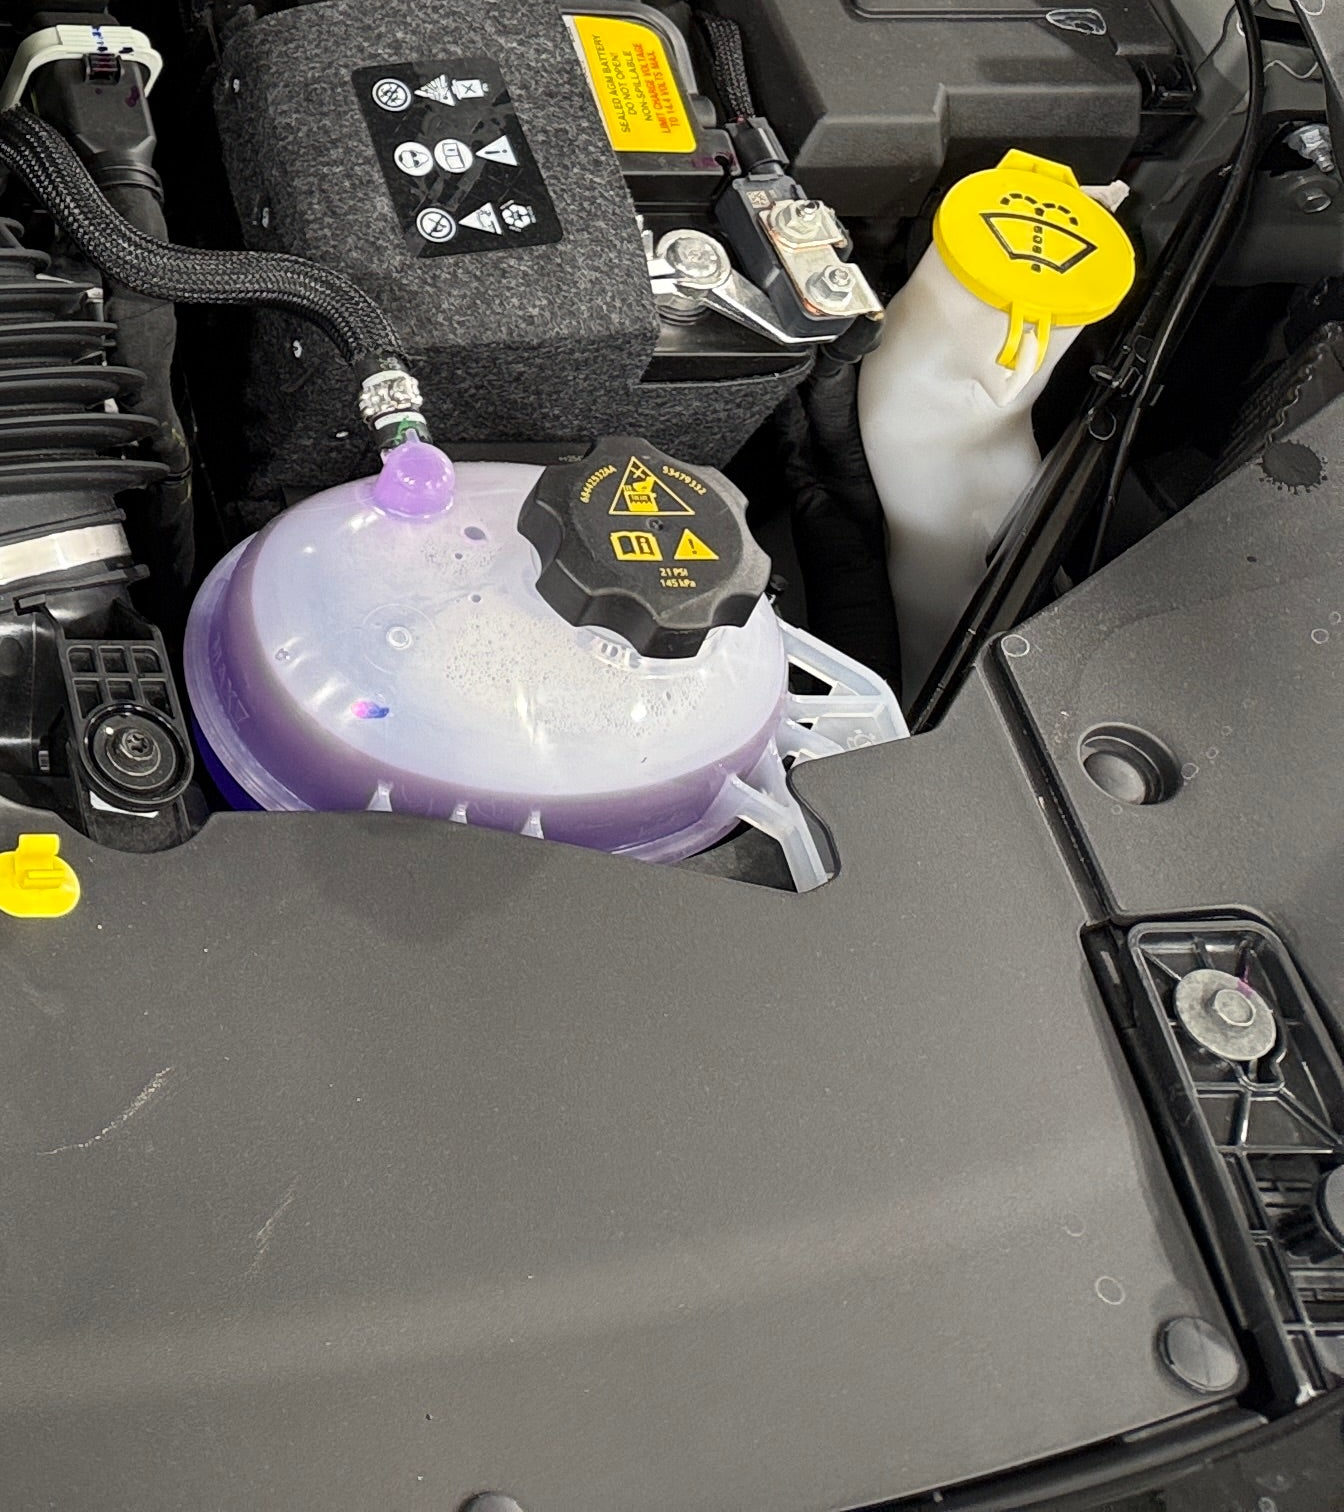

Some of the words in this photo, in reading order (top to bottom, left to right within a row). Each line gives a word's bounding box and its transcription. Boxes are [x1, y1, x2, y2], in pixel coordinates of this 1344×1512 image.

[592, 34, 611, 73] BATTERY
[633, 43, 652, 76] VOLTAGE
[647, 51, 659, 69] MAX
[605, 76, 618, 96] AGM
[618, 82, 631, 100] NOT
[623, 51, 652, 121] NON-SPILLABLE
[655, 72, 669, 96] VOLTS
[645, 80, 662, 110] CHARGE
[613, 98, 630, 133] SEALED
[626, 102, 637, 115] DO
[656, 112, 671, 133] LIMIT
[669, 117, 680, 127] TO
[659, 568, 671, 576] 21
[673, 568, 688, 576] PSI
[660, 579, 678, 587] 145
[679, 579, 696, 587] kPa
